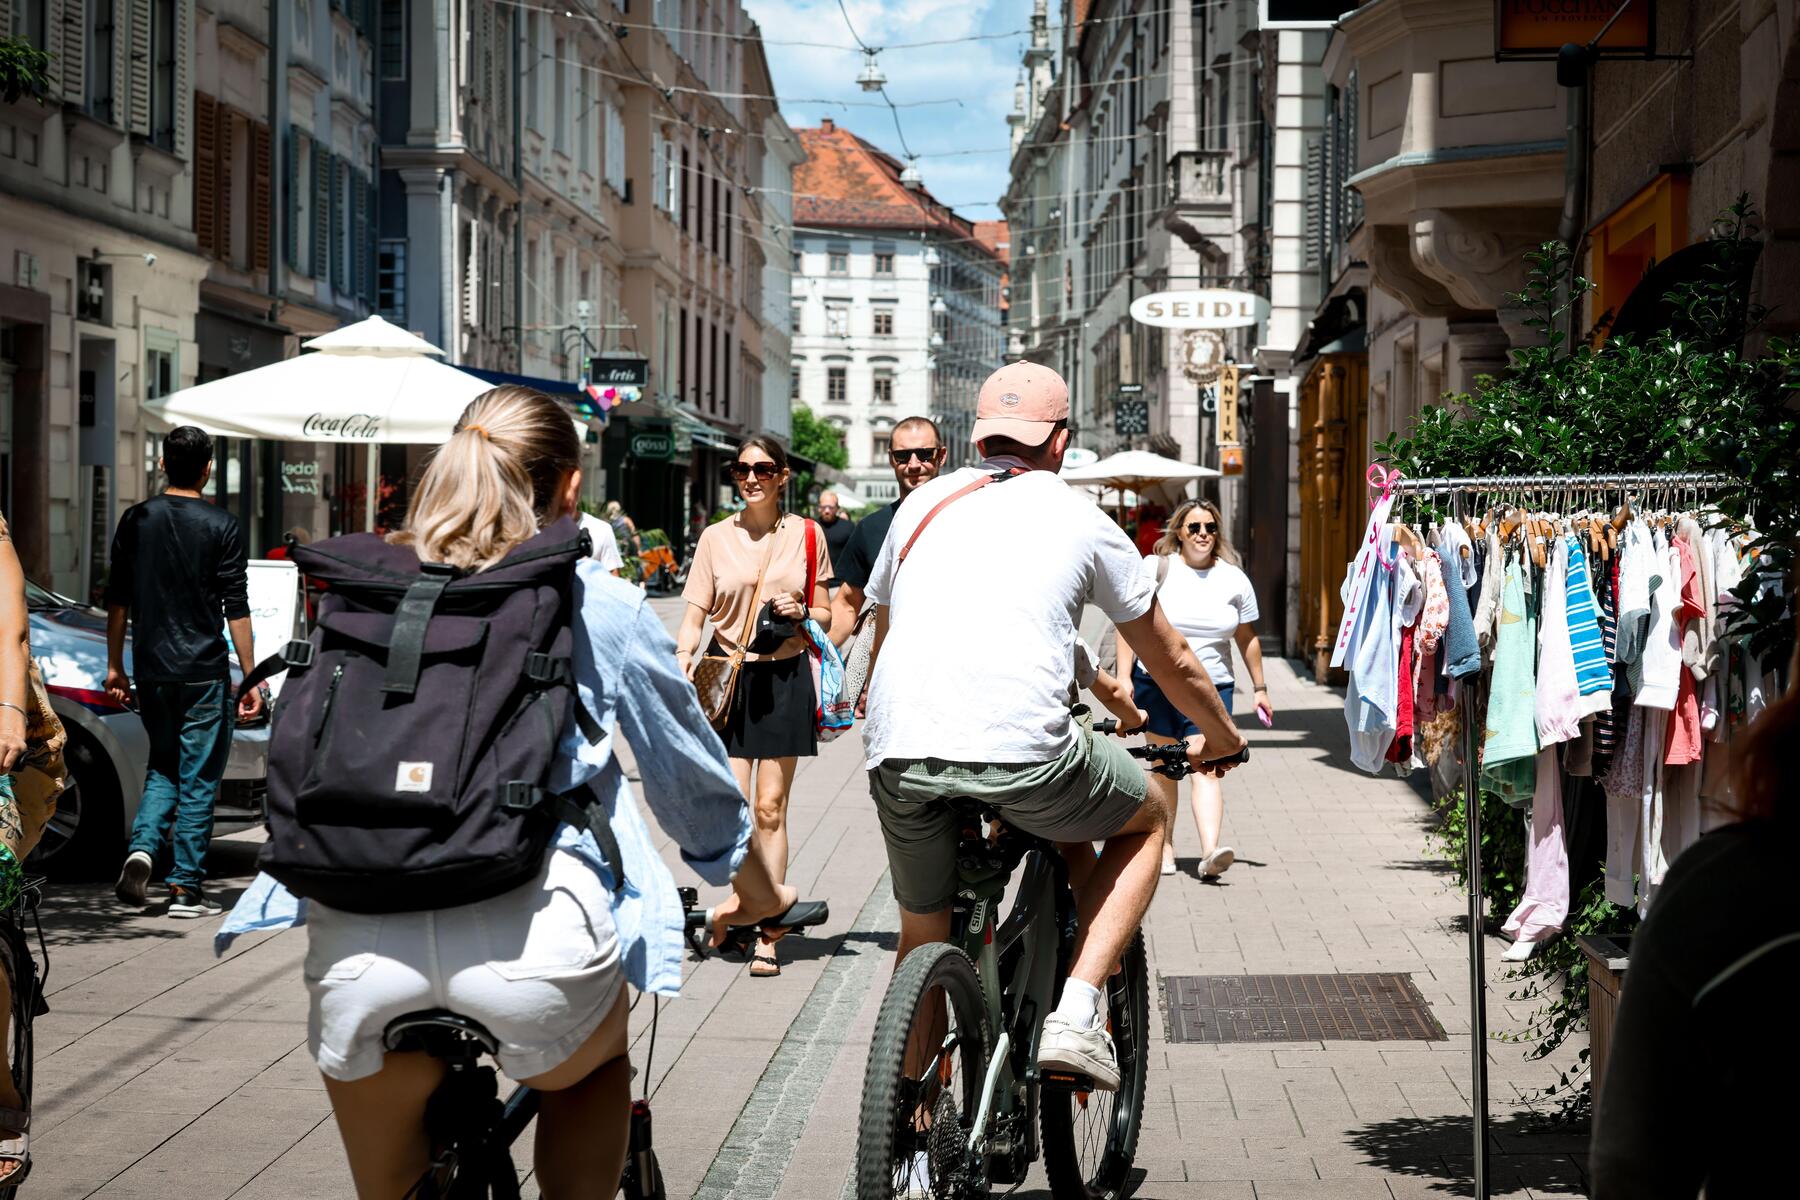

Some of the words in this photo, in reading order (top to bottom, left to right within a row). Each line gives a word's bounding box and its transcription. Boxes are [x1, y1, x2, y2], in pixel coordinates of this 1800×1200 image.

[1145, 301, 1256, 318] SEIDL
[1223, 369, 1234, 441] ANTIK
[1338, 520, 1378, 648] SALE
